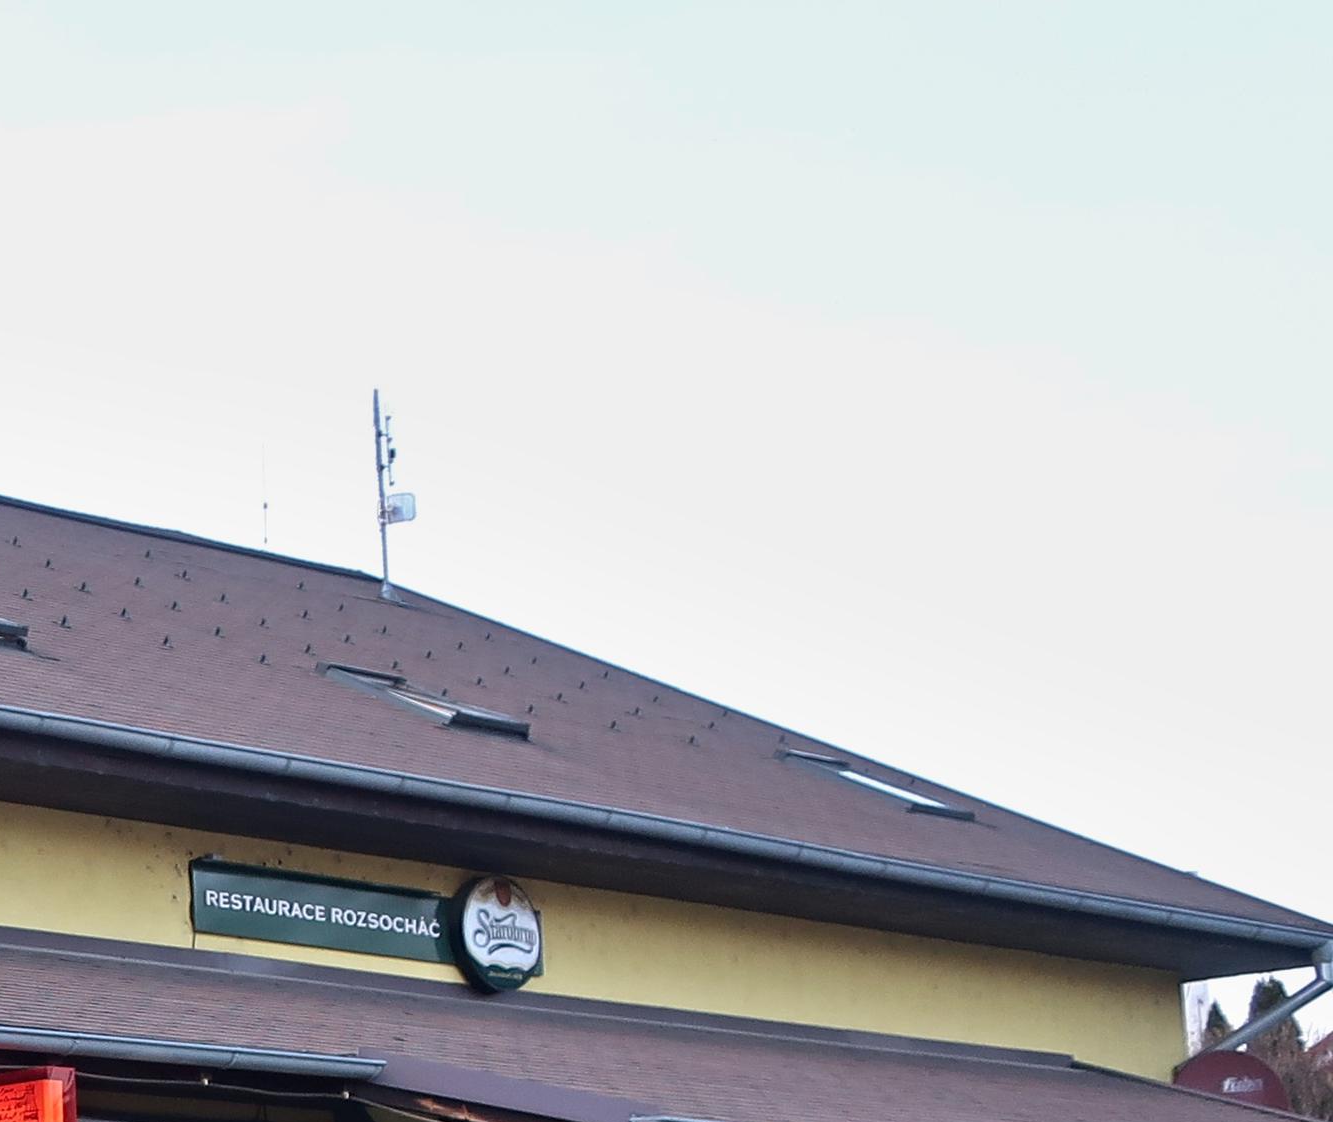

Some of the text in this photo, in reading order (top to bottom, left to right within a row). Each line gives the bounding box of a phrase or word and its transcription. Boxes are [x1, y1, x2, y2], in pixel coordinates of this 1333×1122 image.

[205, 889, 441, 938] RESTAURACE ROZSOCHÁČ
[474, 908, 537, 953] Starobrno
